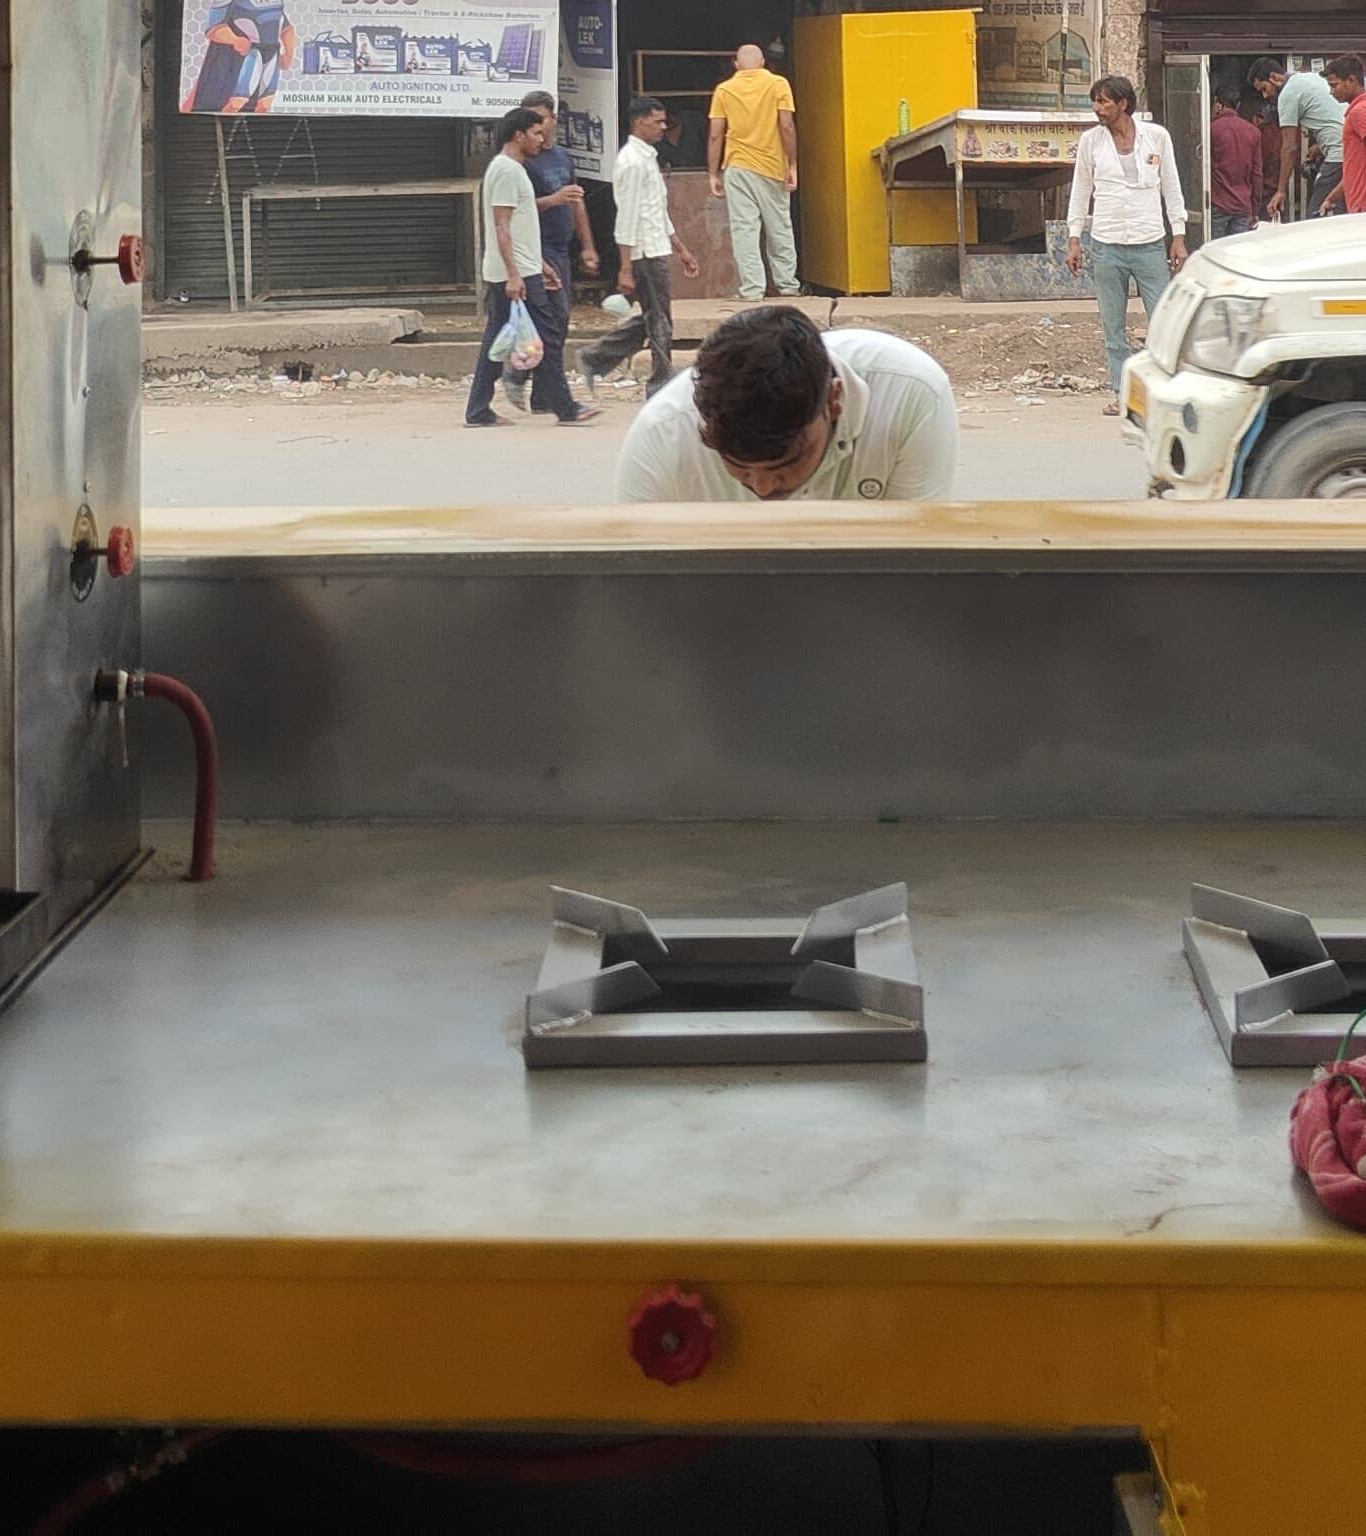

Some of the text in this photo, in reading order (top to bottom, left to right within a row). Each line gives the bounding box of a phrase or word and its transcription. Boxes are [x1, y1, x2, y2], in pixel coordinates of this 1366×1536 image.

[578, 31, 596, 45] LEK
[370, 82, 400, 91] AUTO
[402, 83, 448, 92] IGNITION
[283, 94, 443, 105] MOSHAM KHAN AUTO ELECTRICALS
